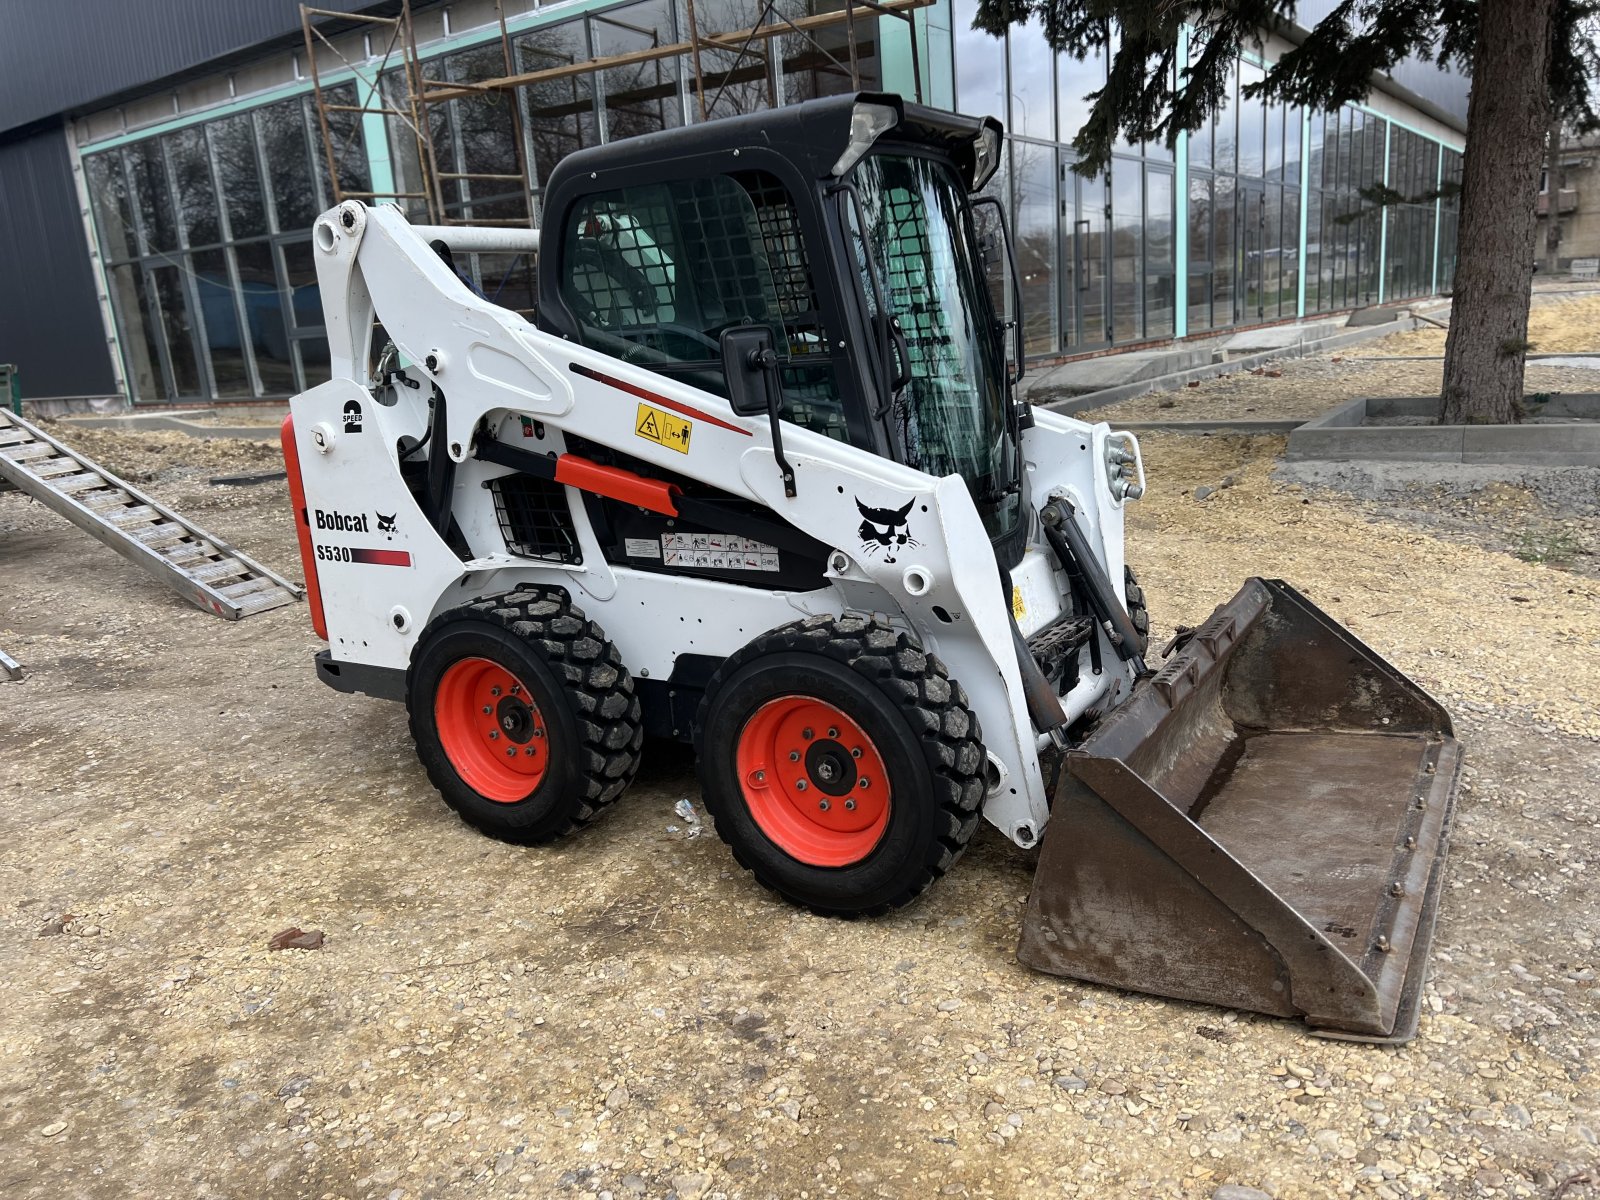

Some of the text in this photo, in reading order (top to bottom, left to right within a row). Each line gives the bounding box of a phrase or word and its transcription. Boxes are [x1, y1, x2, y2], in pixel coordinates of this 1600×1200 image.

[344, 400, 362, 433] 2
[315, 509, 369, 533] Bobcat
[317, 545, 350, 562] S530
